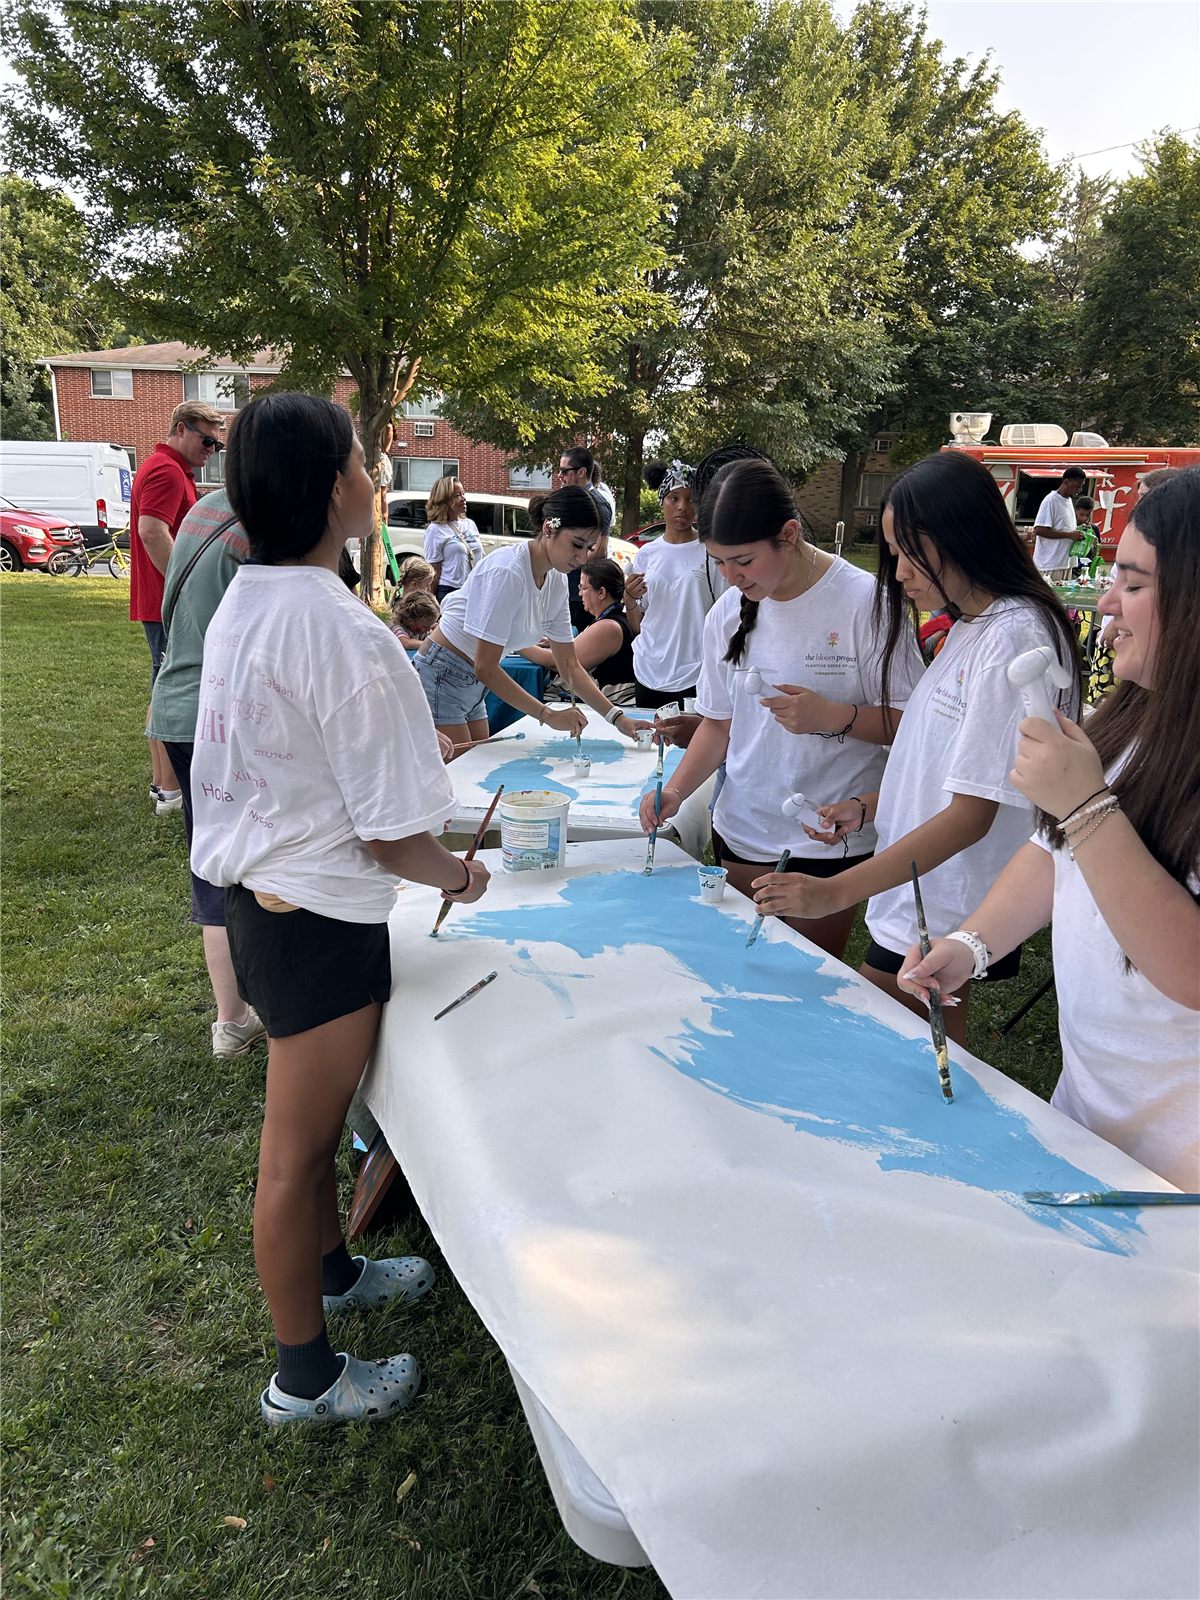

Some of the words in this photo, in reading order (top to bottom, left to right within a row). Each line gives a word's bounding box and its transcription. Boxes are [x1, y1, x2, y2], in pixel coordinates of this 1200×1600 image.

[805, 653, 815, 661] the
[815, 653, 836, 661] bloom
[836, 655, 857, 663] project
[200, 707, 227, 744] Hi
[201, 781, 235, 802] Hola
